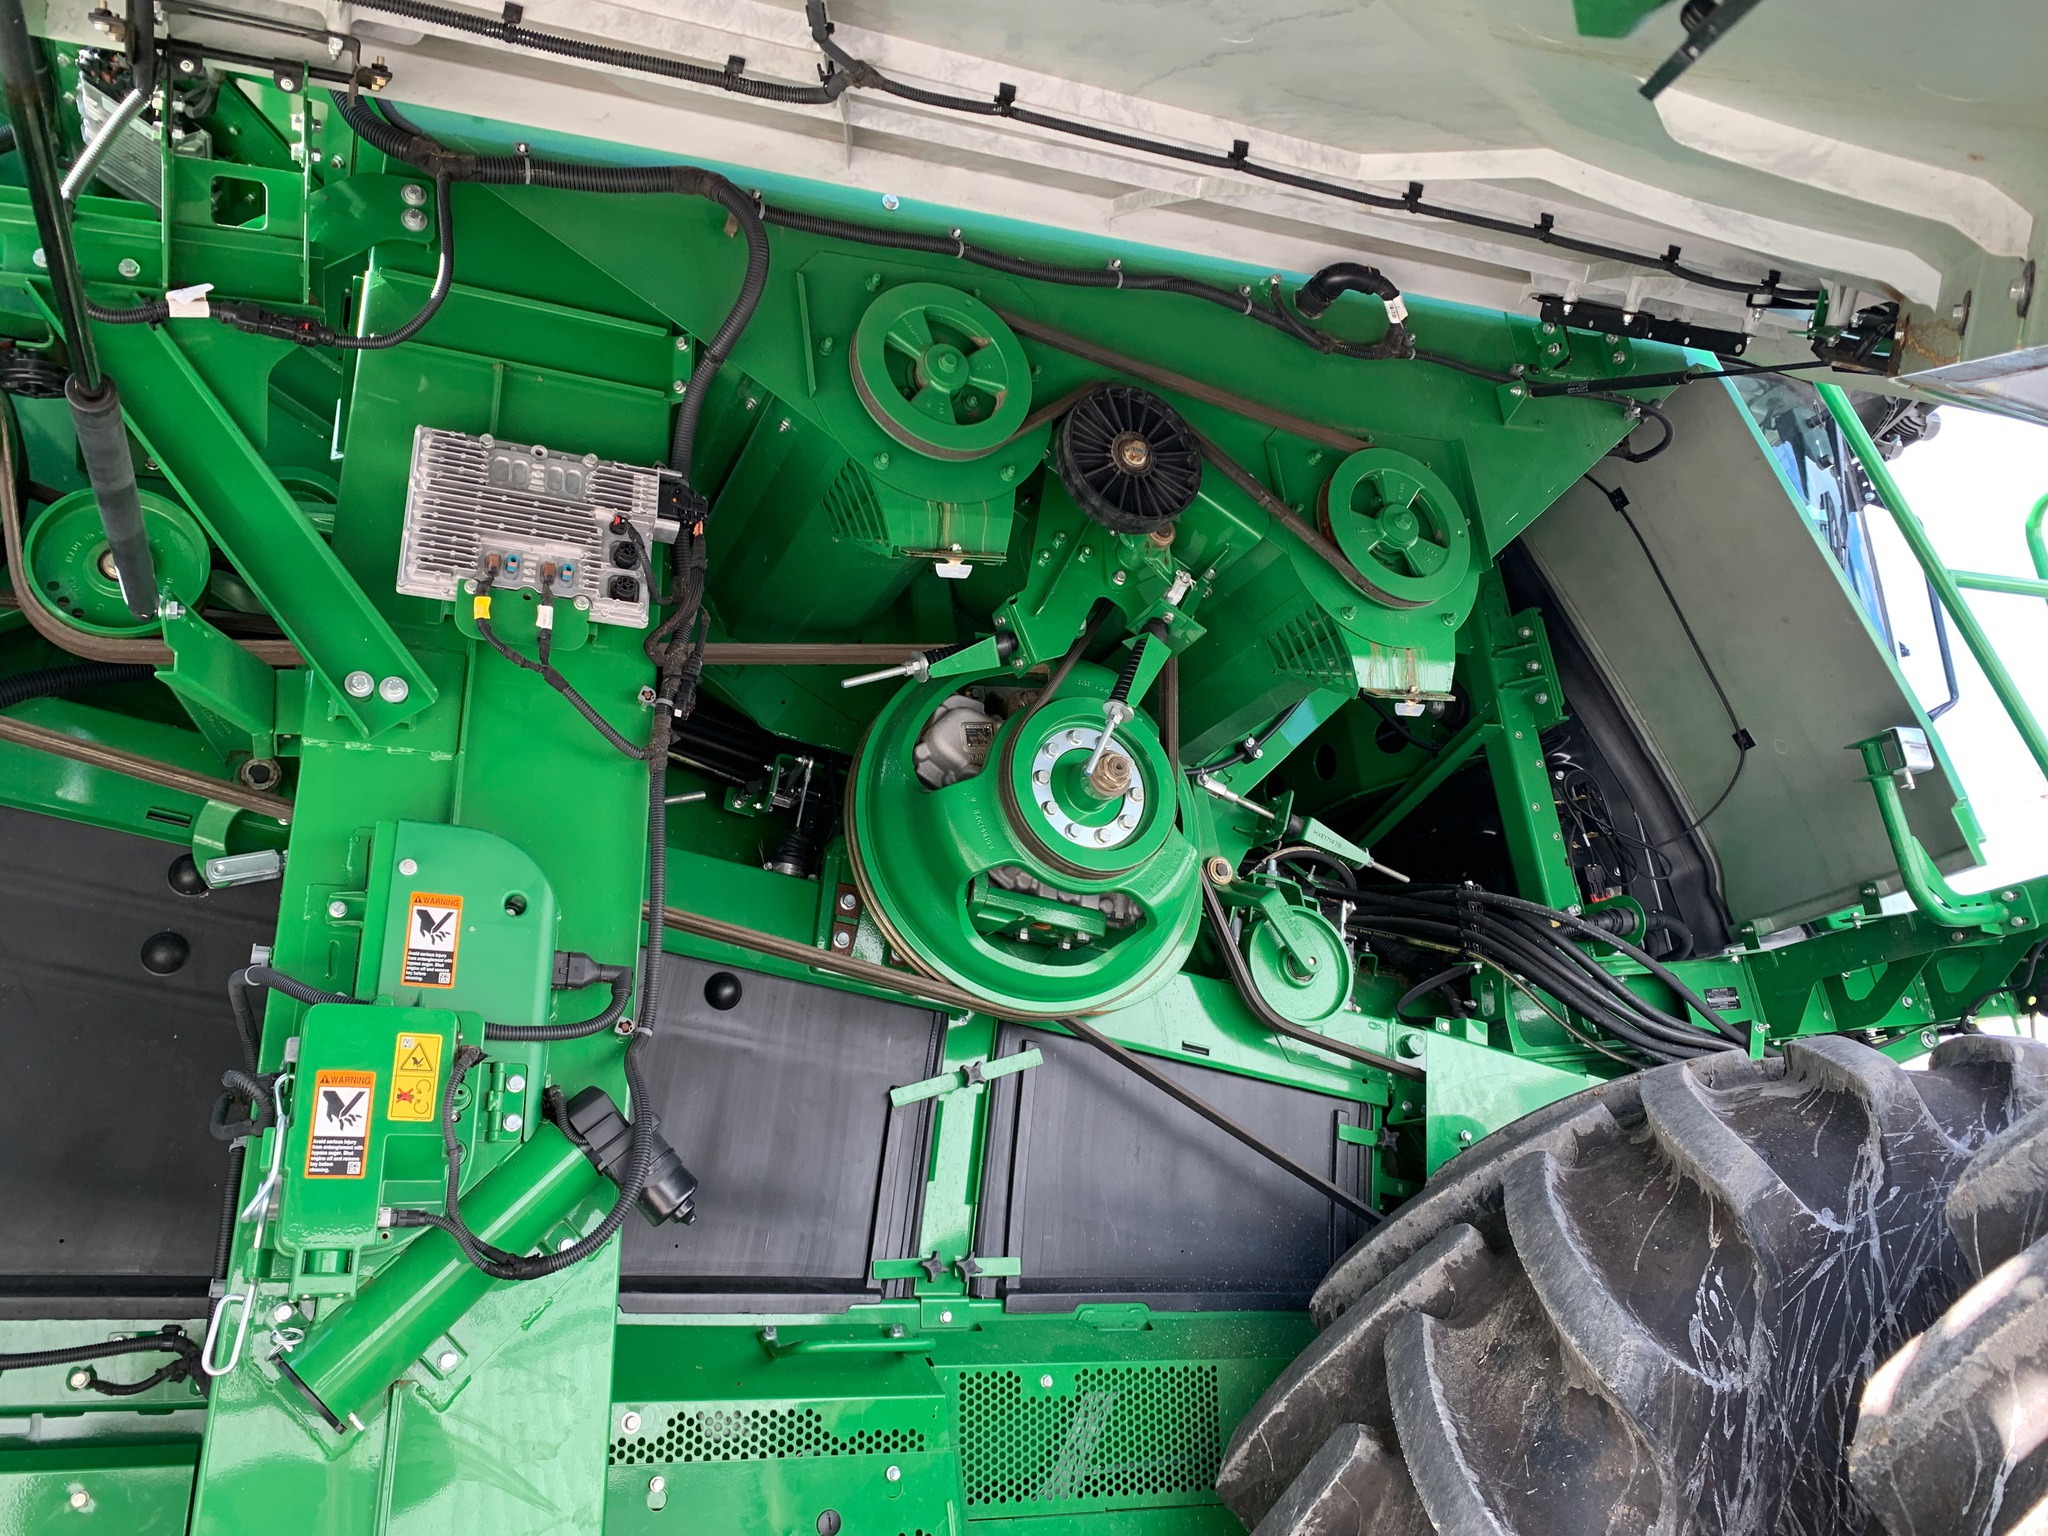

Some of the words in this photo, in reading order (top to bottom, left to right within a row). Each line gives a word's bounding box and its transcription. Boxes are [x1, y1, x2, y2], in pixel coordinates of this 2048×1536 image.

[1313, 830, 1342, 848] HXE171478
[424, 897, 458, 906] WARNING
[331, 1076, 370, 1084] WARNING
